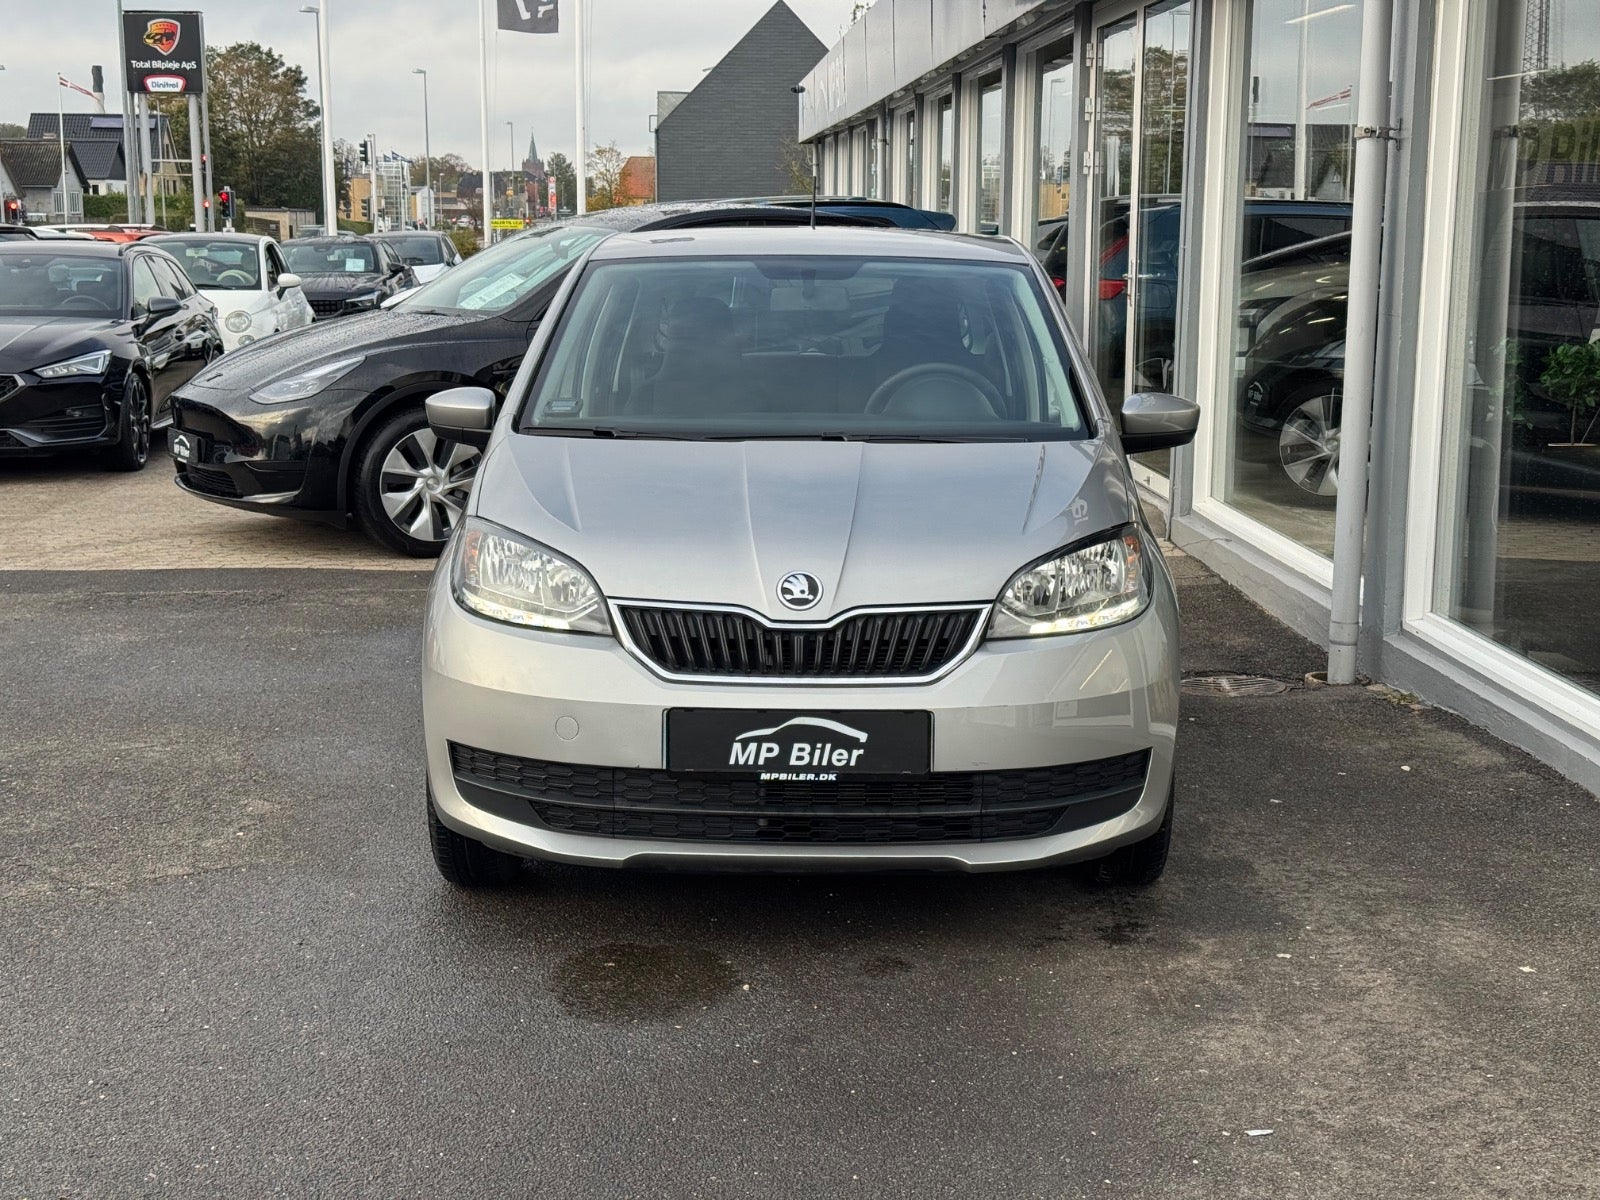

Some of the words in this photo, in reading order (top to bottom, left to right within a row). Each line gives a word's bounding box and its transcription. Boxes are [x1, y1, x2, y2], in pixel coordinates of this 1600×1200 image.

[131, 60, 151, 69] Total
[152, 60, 180, 70] Bilpleje
[181, 60, 197, 70] ApS
[151, 81, 179, 89] Dinitrol
[729, 742, 780, 766] MP
[789, 743, 864, 767] Biler
[760, 772, 838, 781] MPBILER.DK
